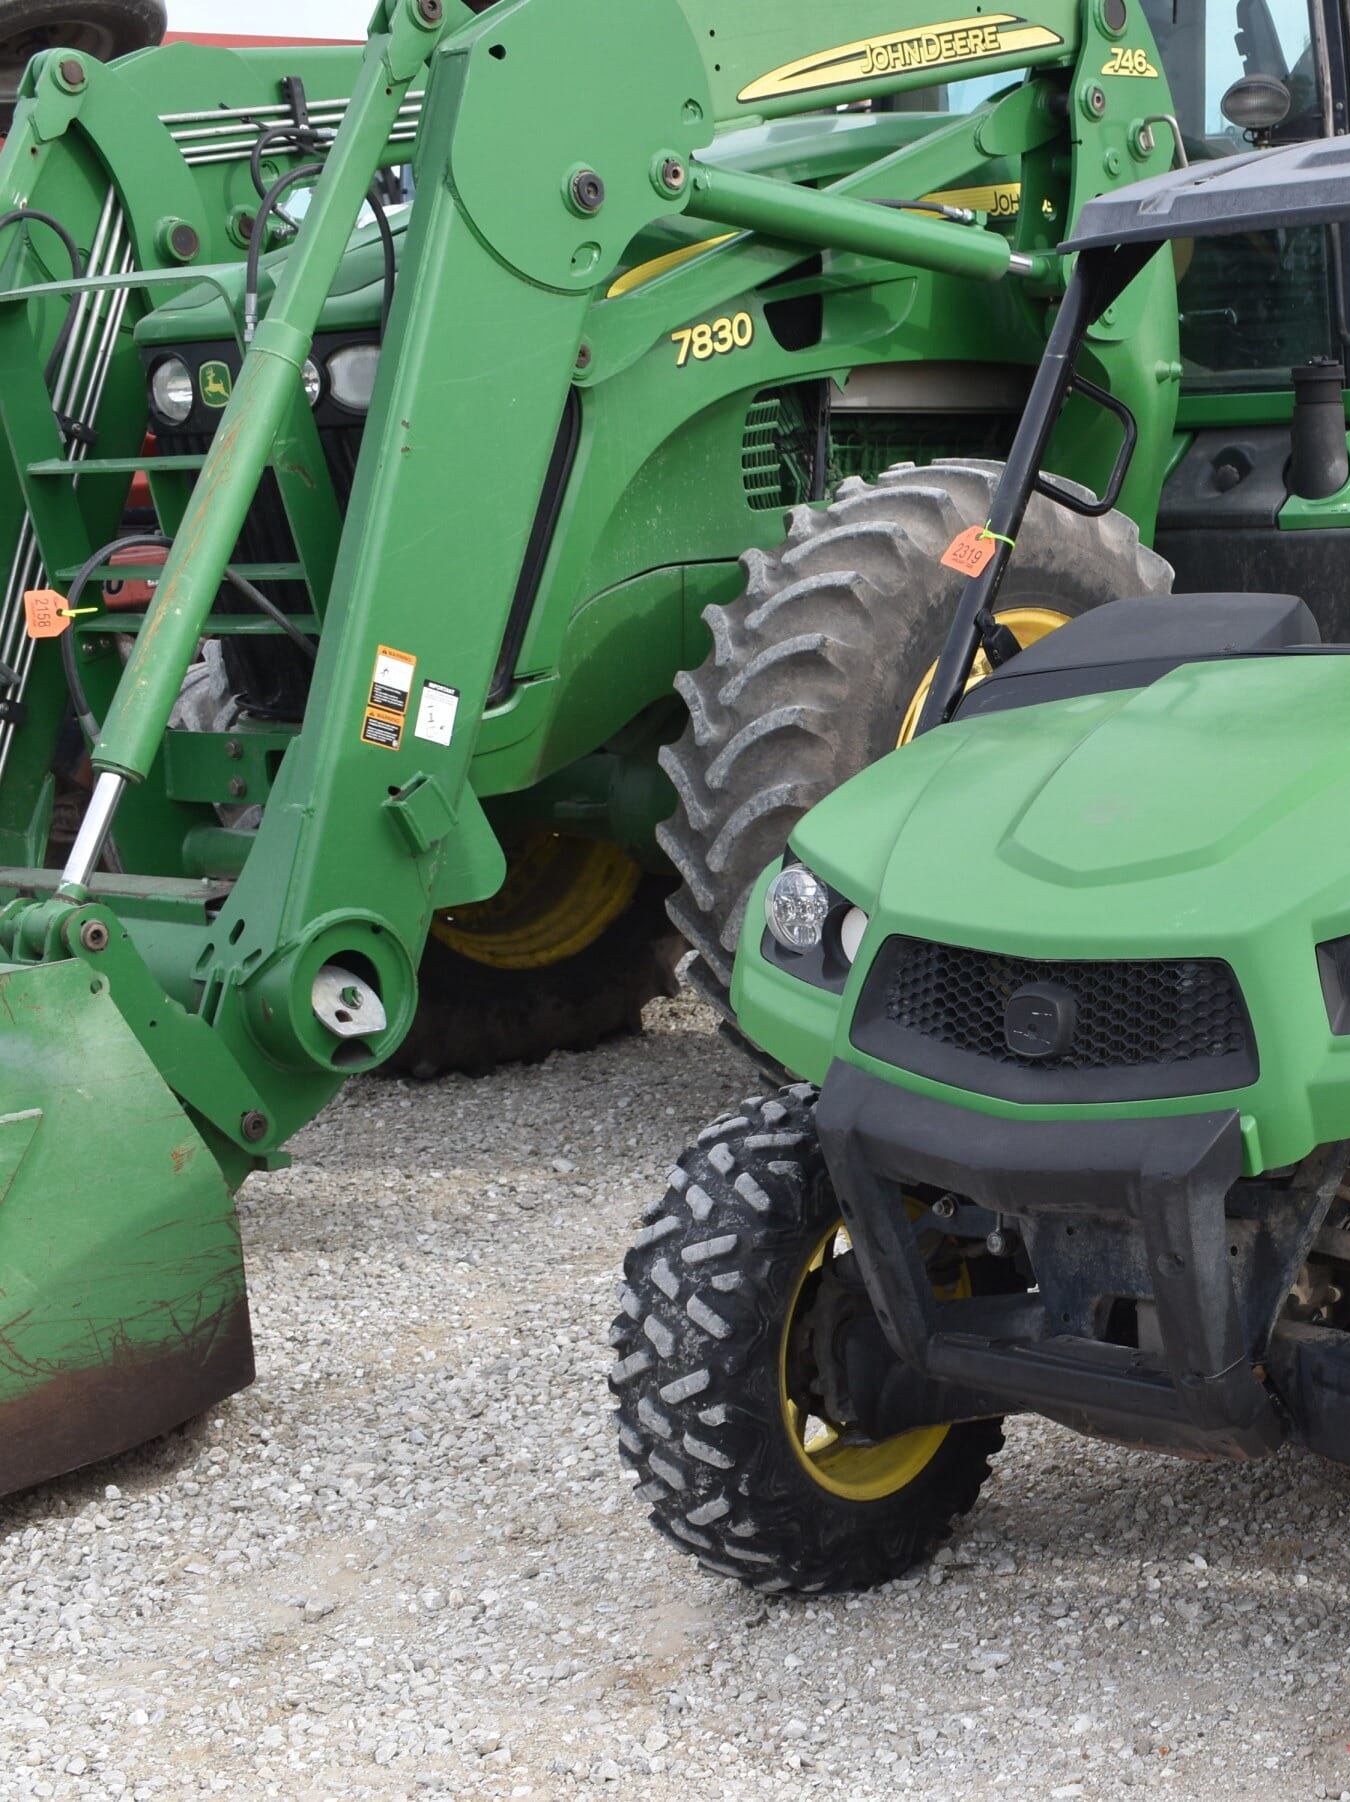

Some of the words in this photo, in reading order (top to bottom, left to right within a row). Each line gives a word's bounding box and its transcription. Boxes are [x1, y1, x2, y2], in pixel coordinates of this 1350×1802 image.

[860, 40, 923, 74] JOHN
[921, 24, 1001, 61] DEERE
[1110, 47, 1148, 74] 746
[990, 191, 1021, 216] JOH
[671, 311, 753, 368] 7830
[952, 542, 983, 564] 2319
[34, 598, 52, 628] 2158
